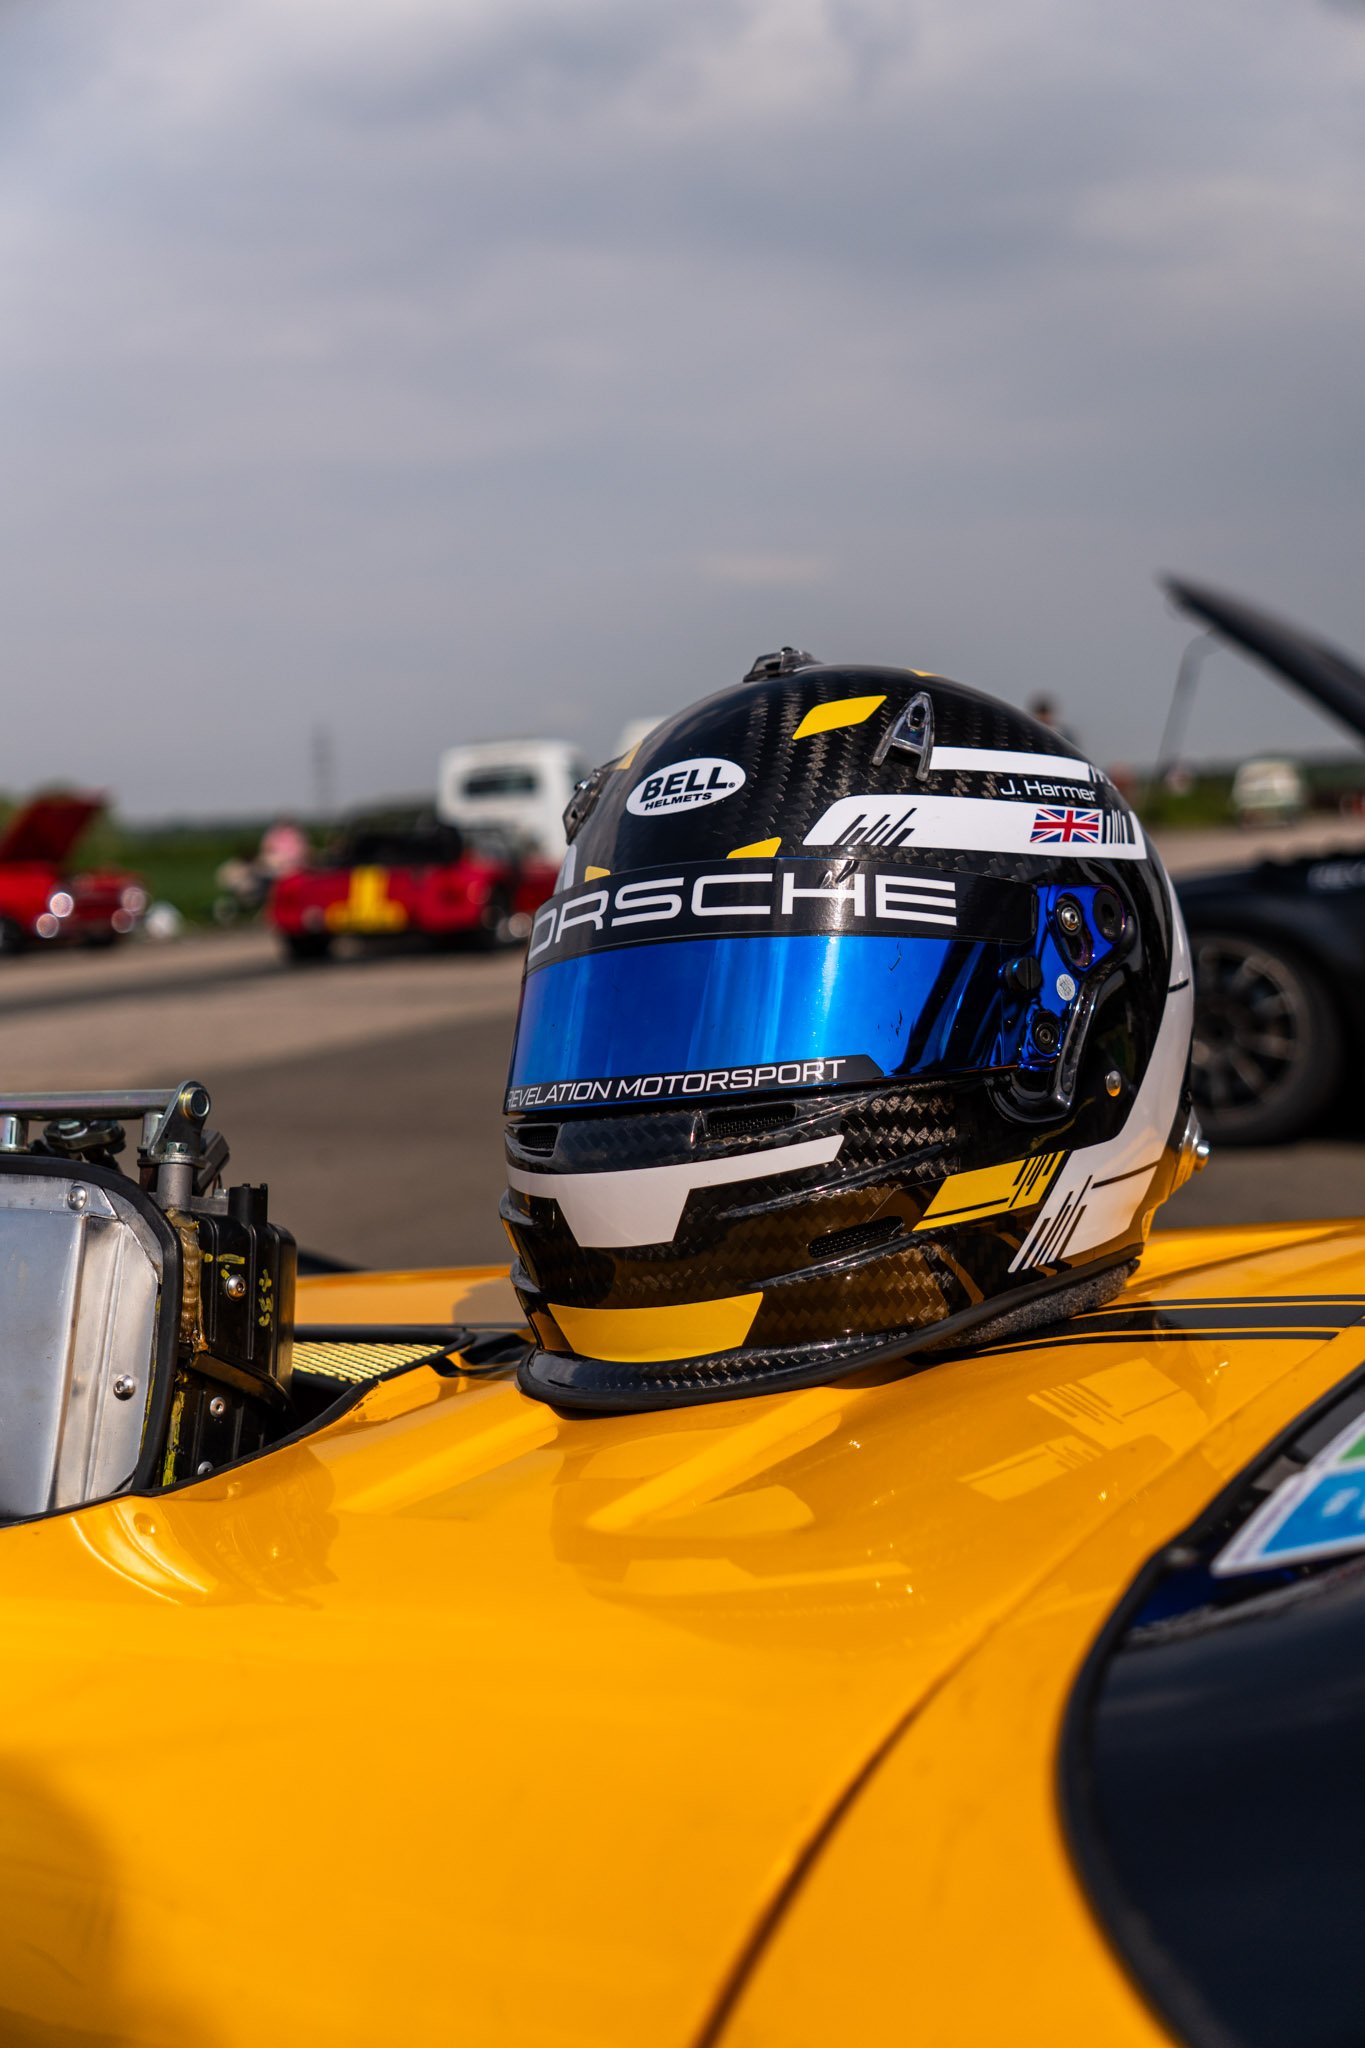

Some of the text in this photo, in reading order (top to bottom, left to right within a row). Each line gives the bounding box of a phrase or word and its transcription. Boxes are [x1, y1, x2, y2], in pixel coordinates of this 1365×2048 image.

[644, 792, 712, 811] HELMETS
[1000, 779, 1096, 802] J. Harmer
[616, 1059, 846, 1098] MOTORSPORT
